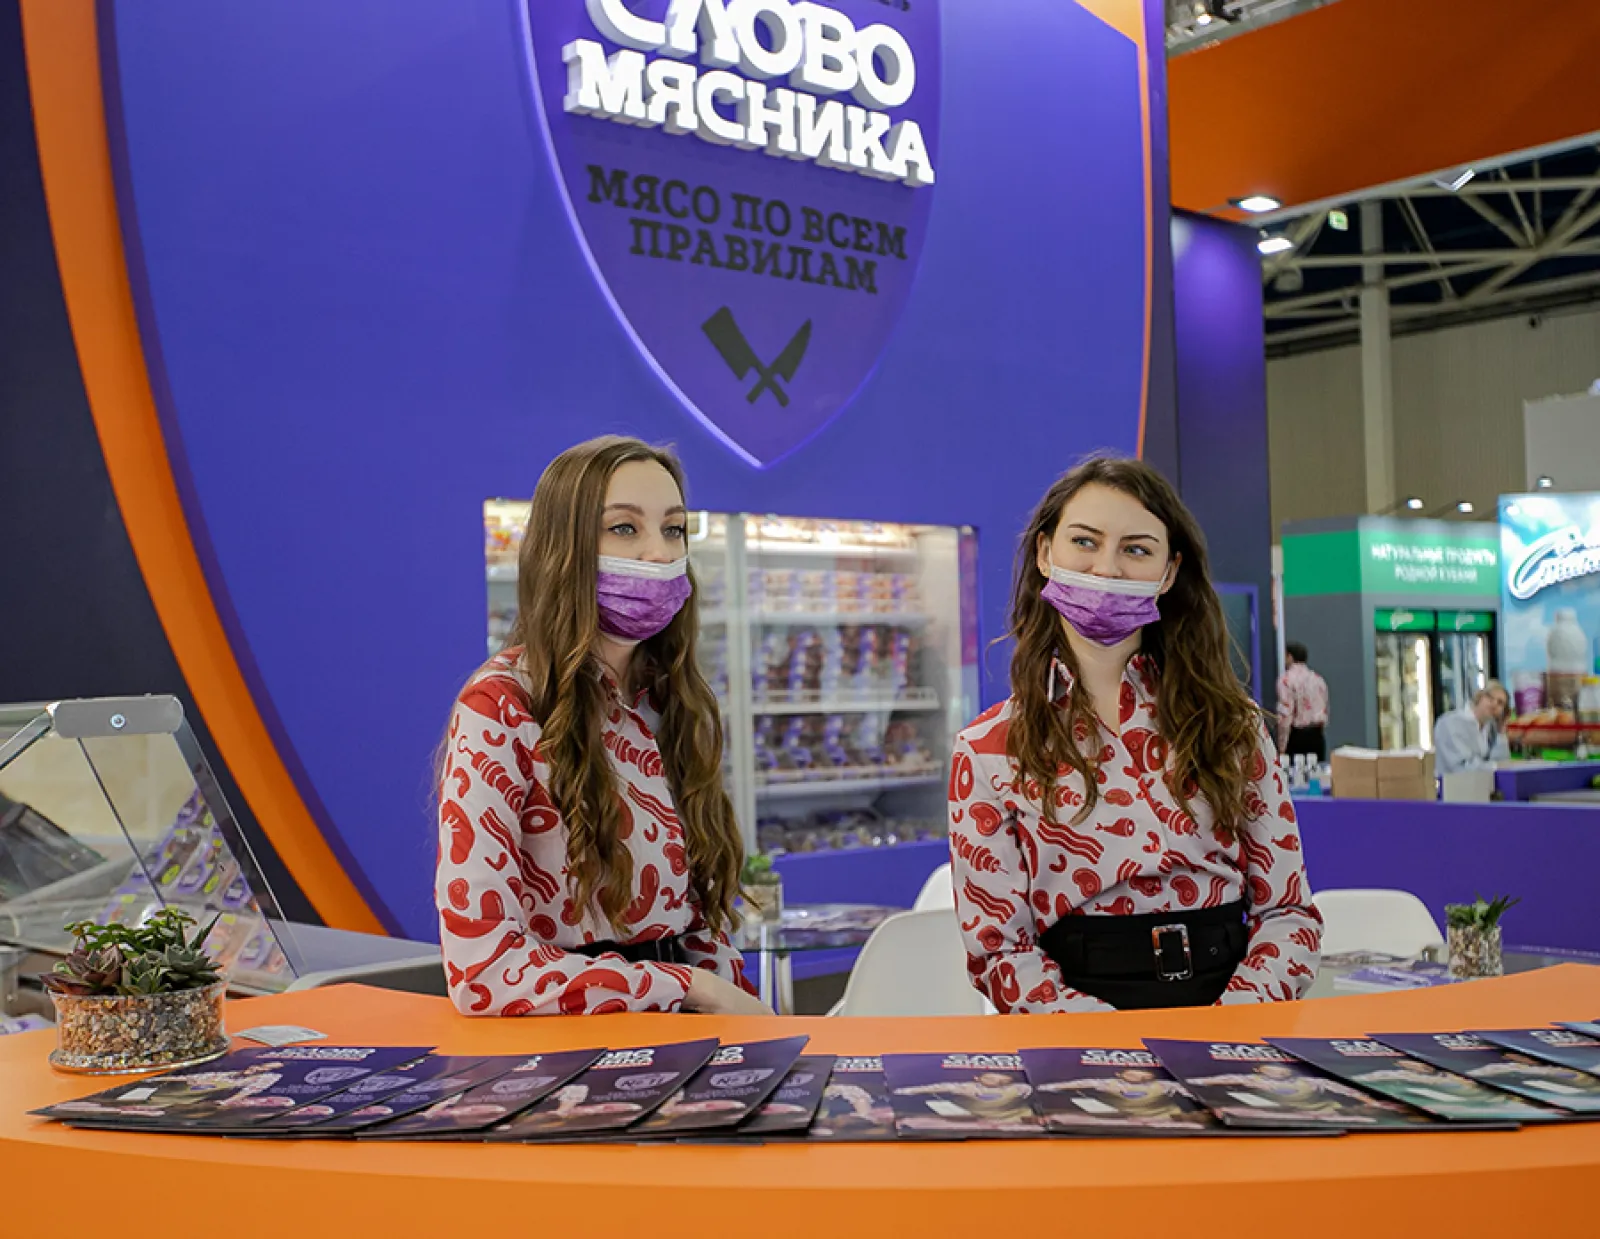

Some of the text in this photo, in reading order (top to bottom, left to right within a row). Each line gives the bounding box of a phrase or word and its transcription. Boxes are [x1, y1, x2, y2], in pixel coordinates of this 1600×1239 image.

[563, 39, 935, 187] МЯСНИКА
[586, 165, 908, 260] МЯСО ПО ВСЕМ
[629, 217, 879, 294] ПРАВИЛАМ
